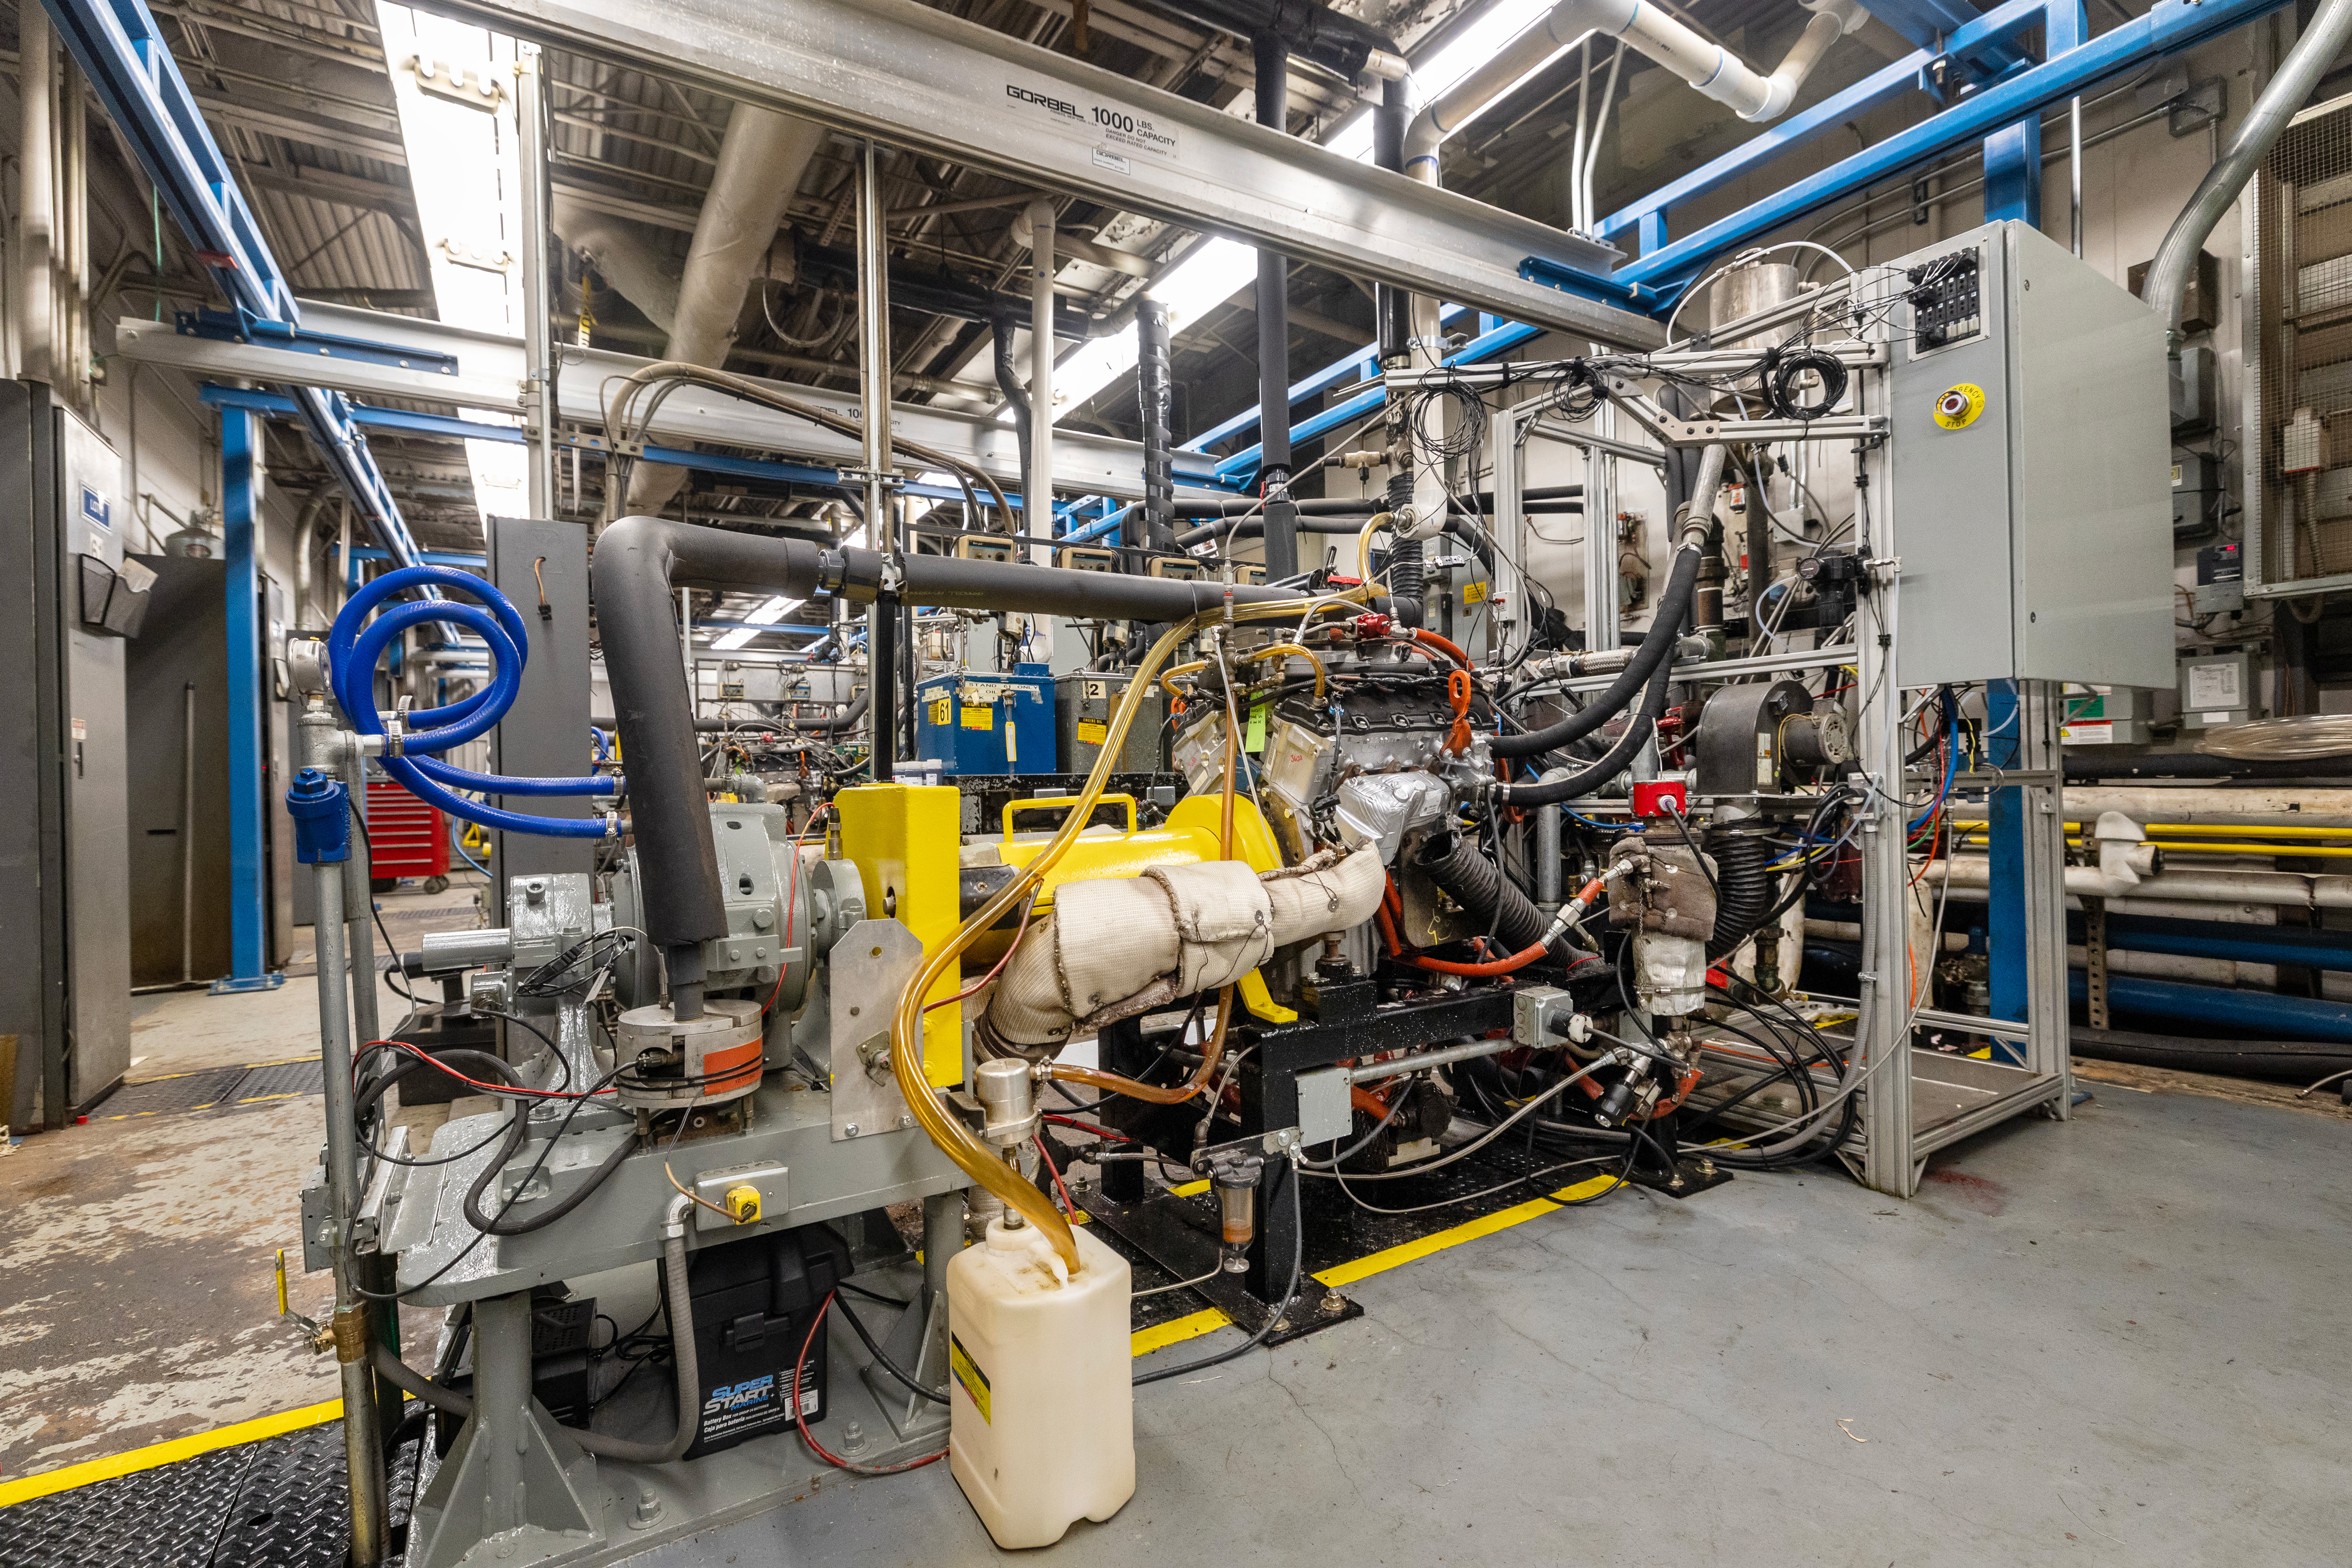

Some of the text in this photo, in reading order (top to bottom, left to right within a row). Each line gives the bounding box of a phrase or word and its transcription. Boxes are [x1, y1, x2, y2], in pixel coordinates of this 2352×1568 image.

[1007, 84, 1084, 119] GORBEL
[1092, 106, 1133, 132] 1000
[1137, 119, 1154, 131] LBS.
[1105, 128, 1126, 138] DANGER
[1137, 129, 1176, 146] CAPACITY
[1106, 134, 1167, 156] EXCEED RATED CAPACITY
[1096, 150, 1126, 163] GORBEL
[1945, 419, 1967, 427] STOP
[1089, 684, 1099, 695] 2
[940, 702, 949, 722] 61
[711, 1375, 773, 1401] SUPER
[703, 1384, 775, 1415] START
[731, 1395, 769, 1410] MARINE
[704, 1417, 722, 1426] Battery
[728, 1416, 745, 1425] batería
